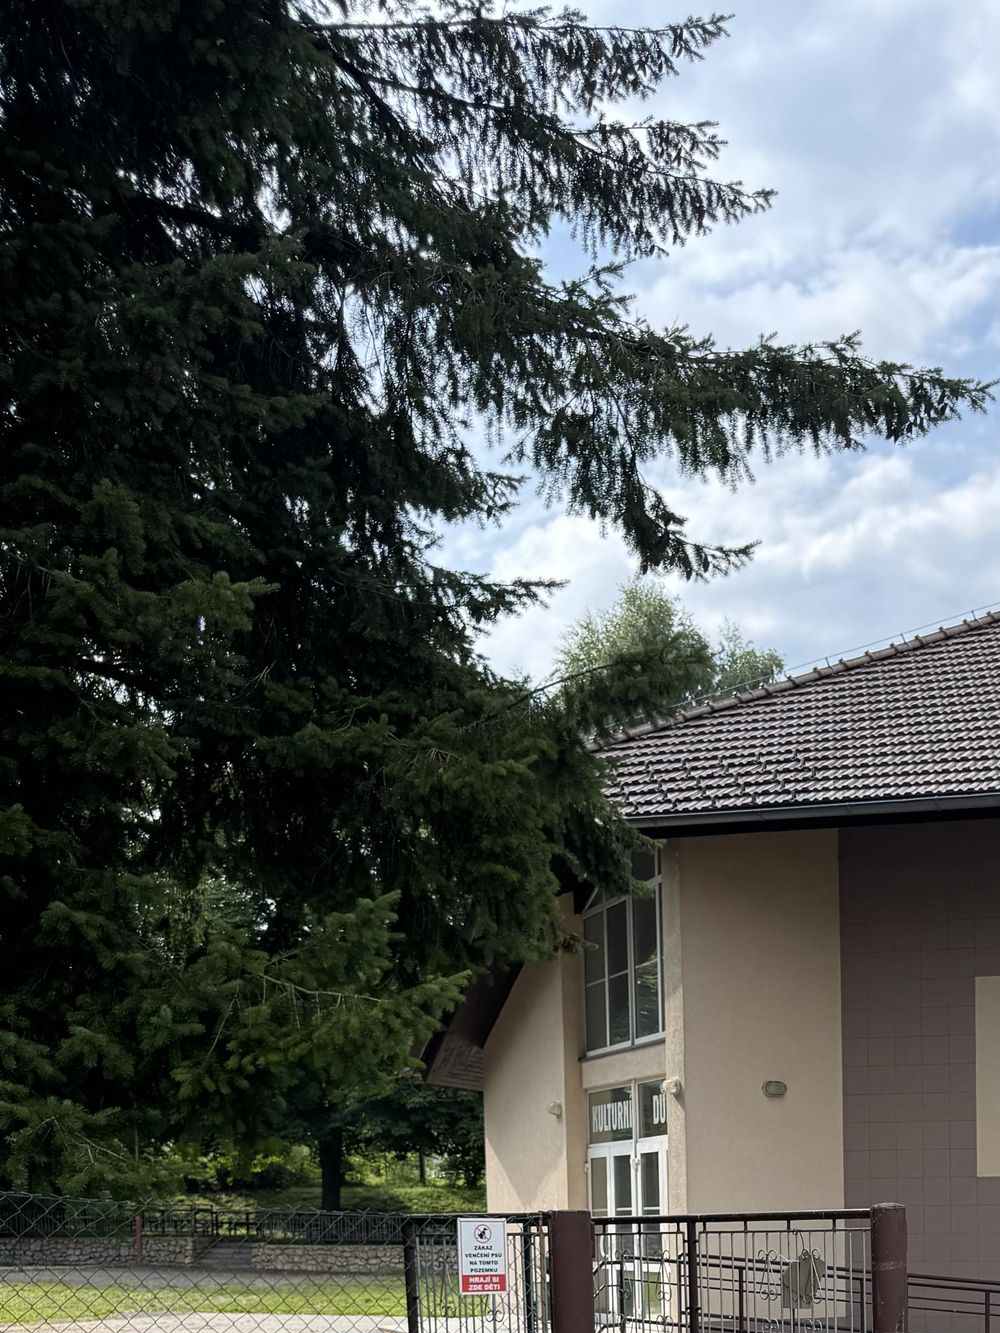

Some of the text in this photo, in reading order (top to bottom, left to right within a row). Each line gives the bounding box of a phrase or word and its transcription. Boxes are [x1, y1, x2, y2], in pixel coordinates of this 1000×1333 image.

[592, 1094, 633, 1133] KULTURNÍ
[469, 1276, 491, 1284] HRAJÍ
[484, 1283, 501, 1291] DĚTI
